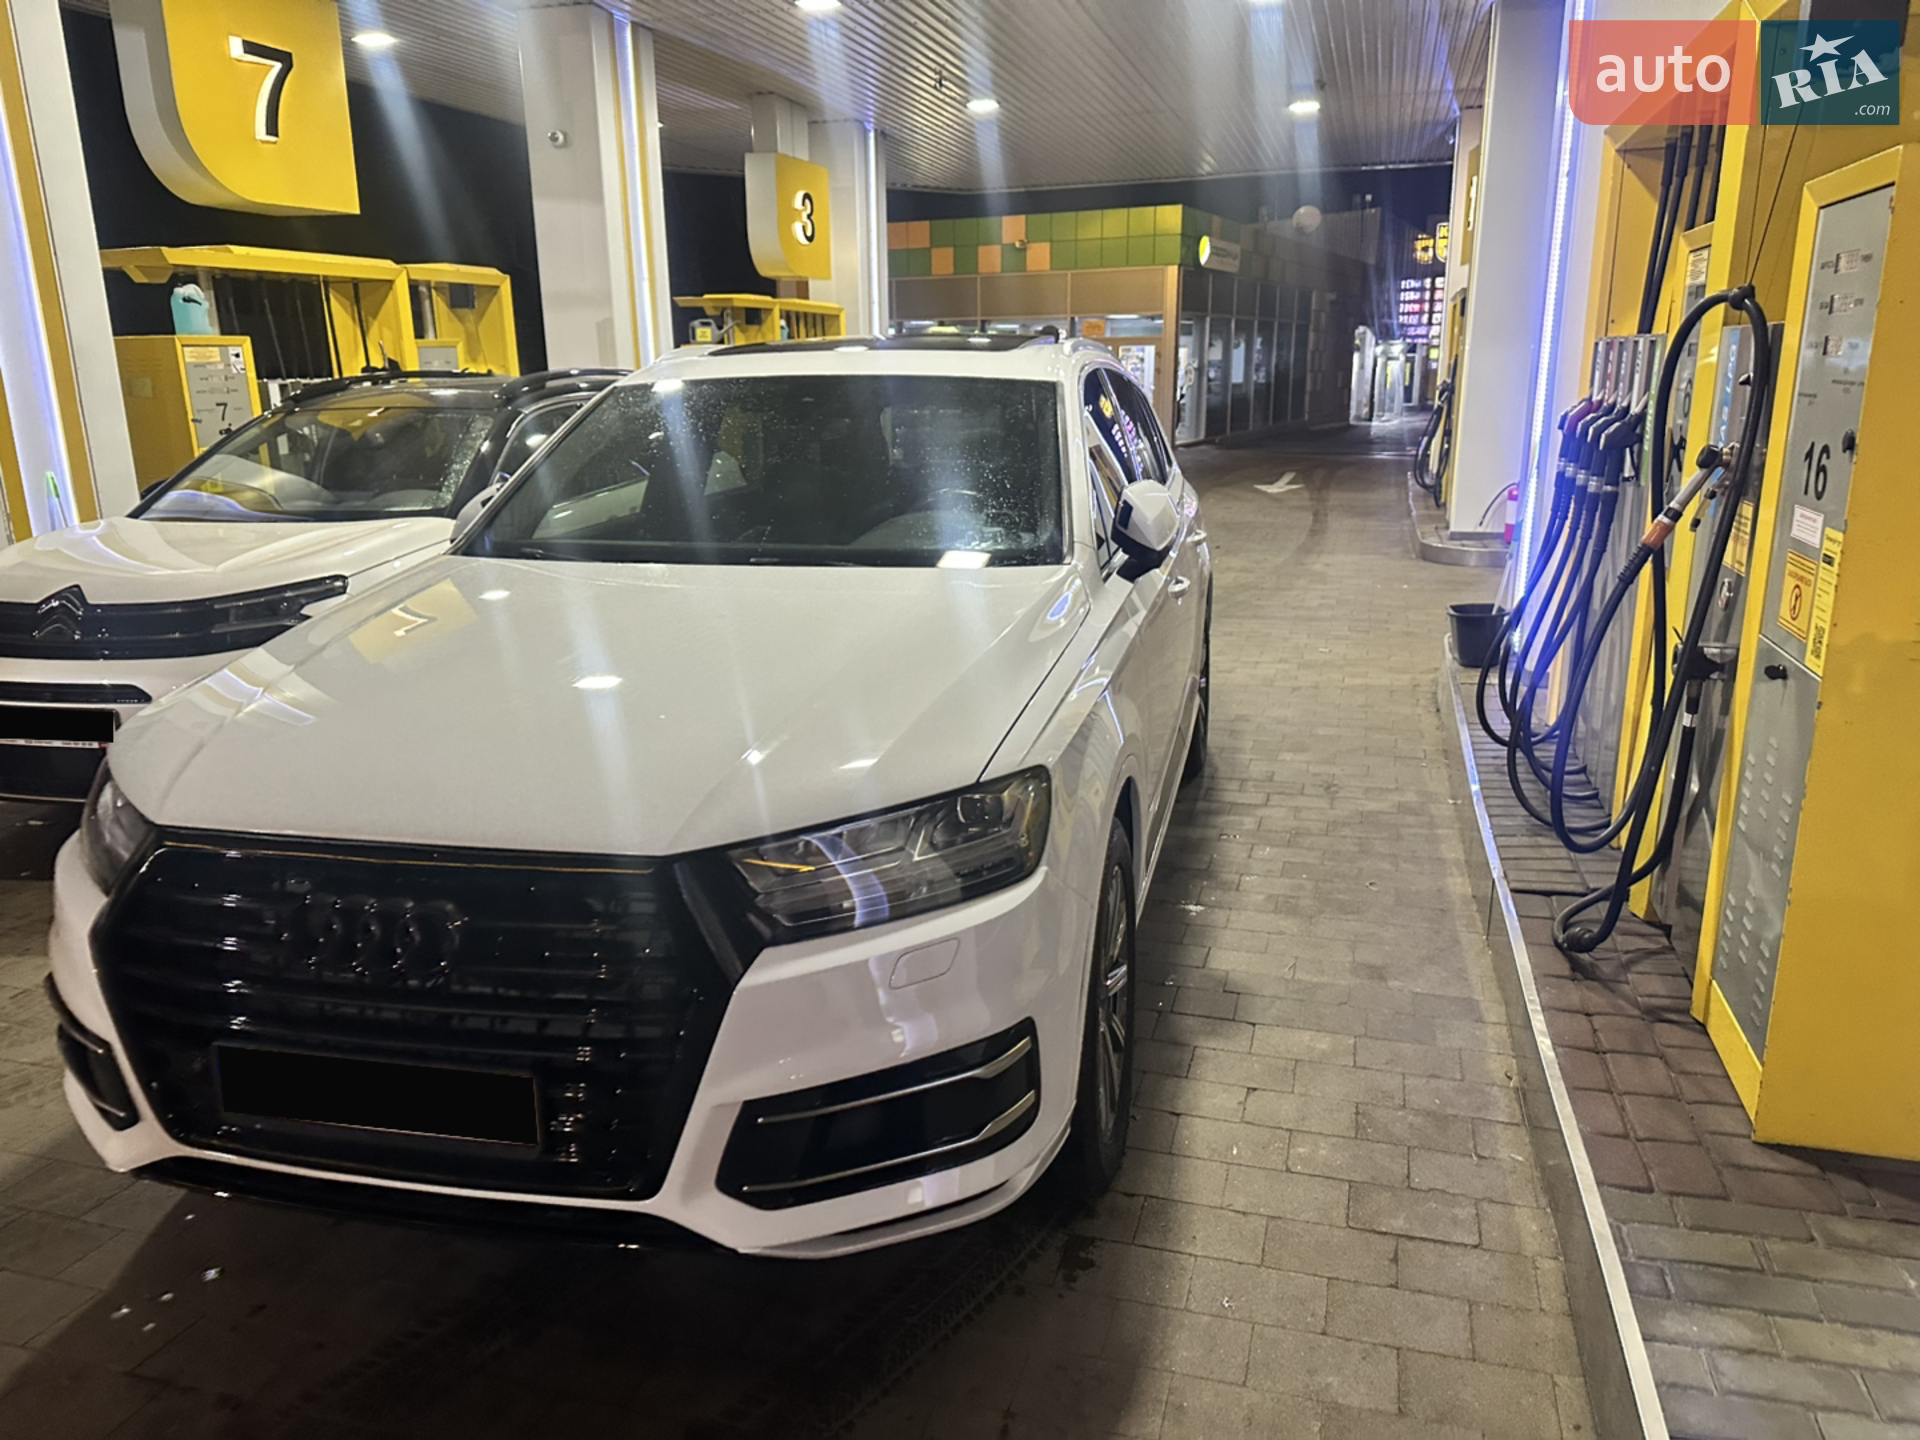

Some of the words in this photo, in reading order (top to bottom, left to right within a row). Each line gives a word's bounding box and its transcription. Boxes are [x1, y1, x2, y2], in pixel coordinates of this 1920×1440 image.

[228, 35, 294, 142] 7
[792, 189, 816, 246] 3
[215, 402, 229, 422] 7
[1803, 440, 1831, 501] 16
